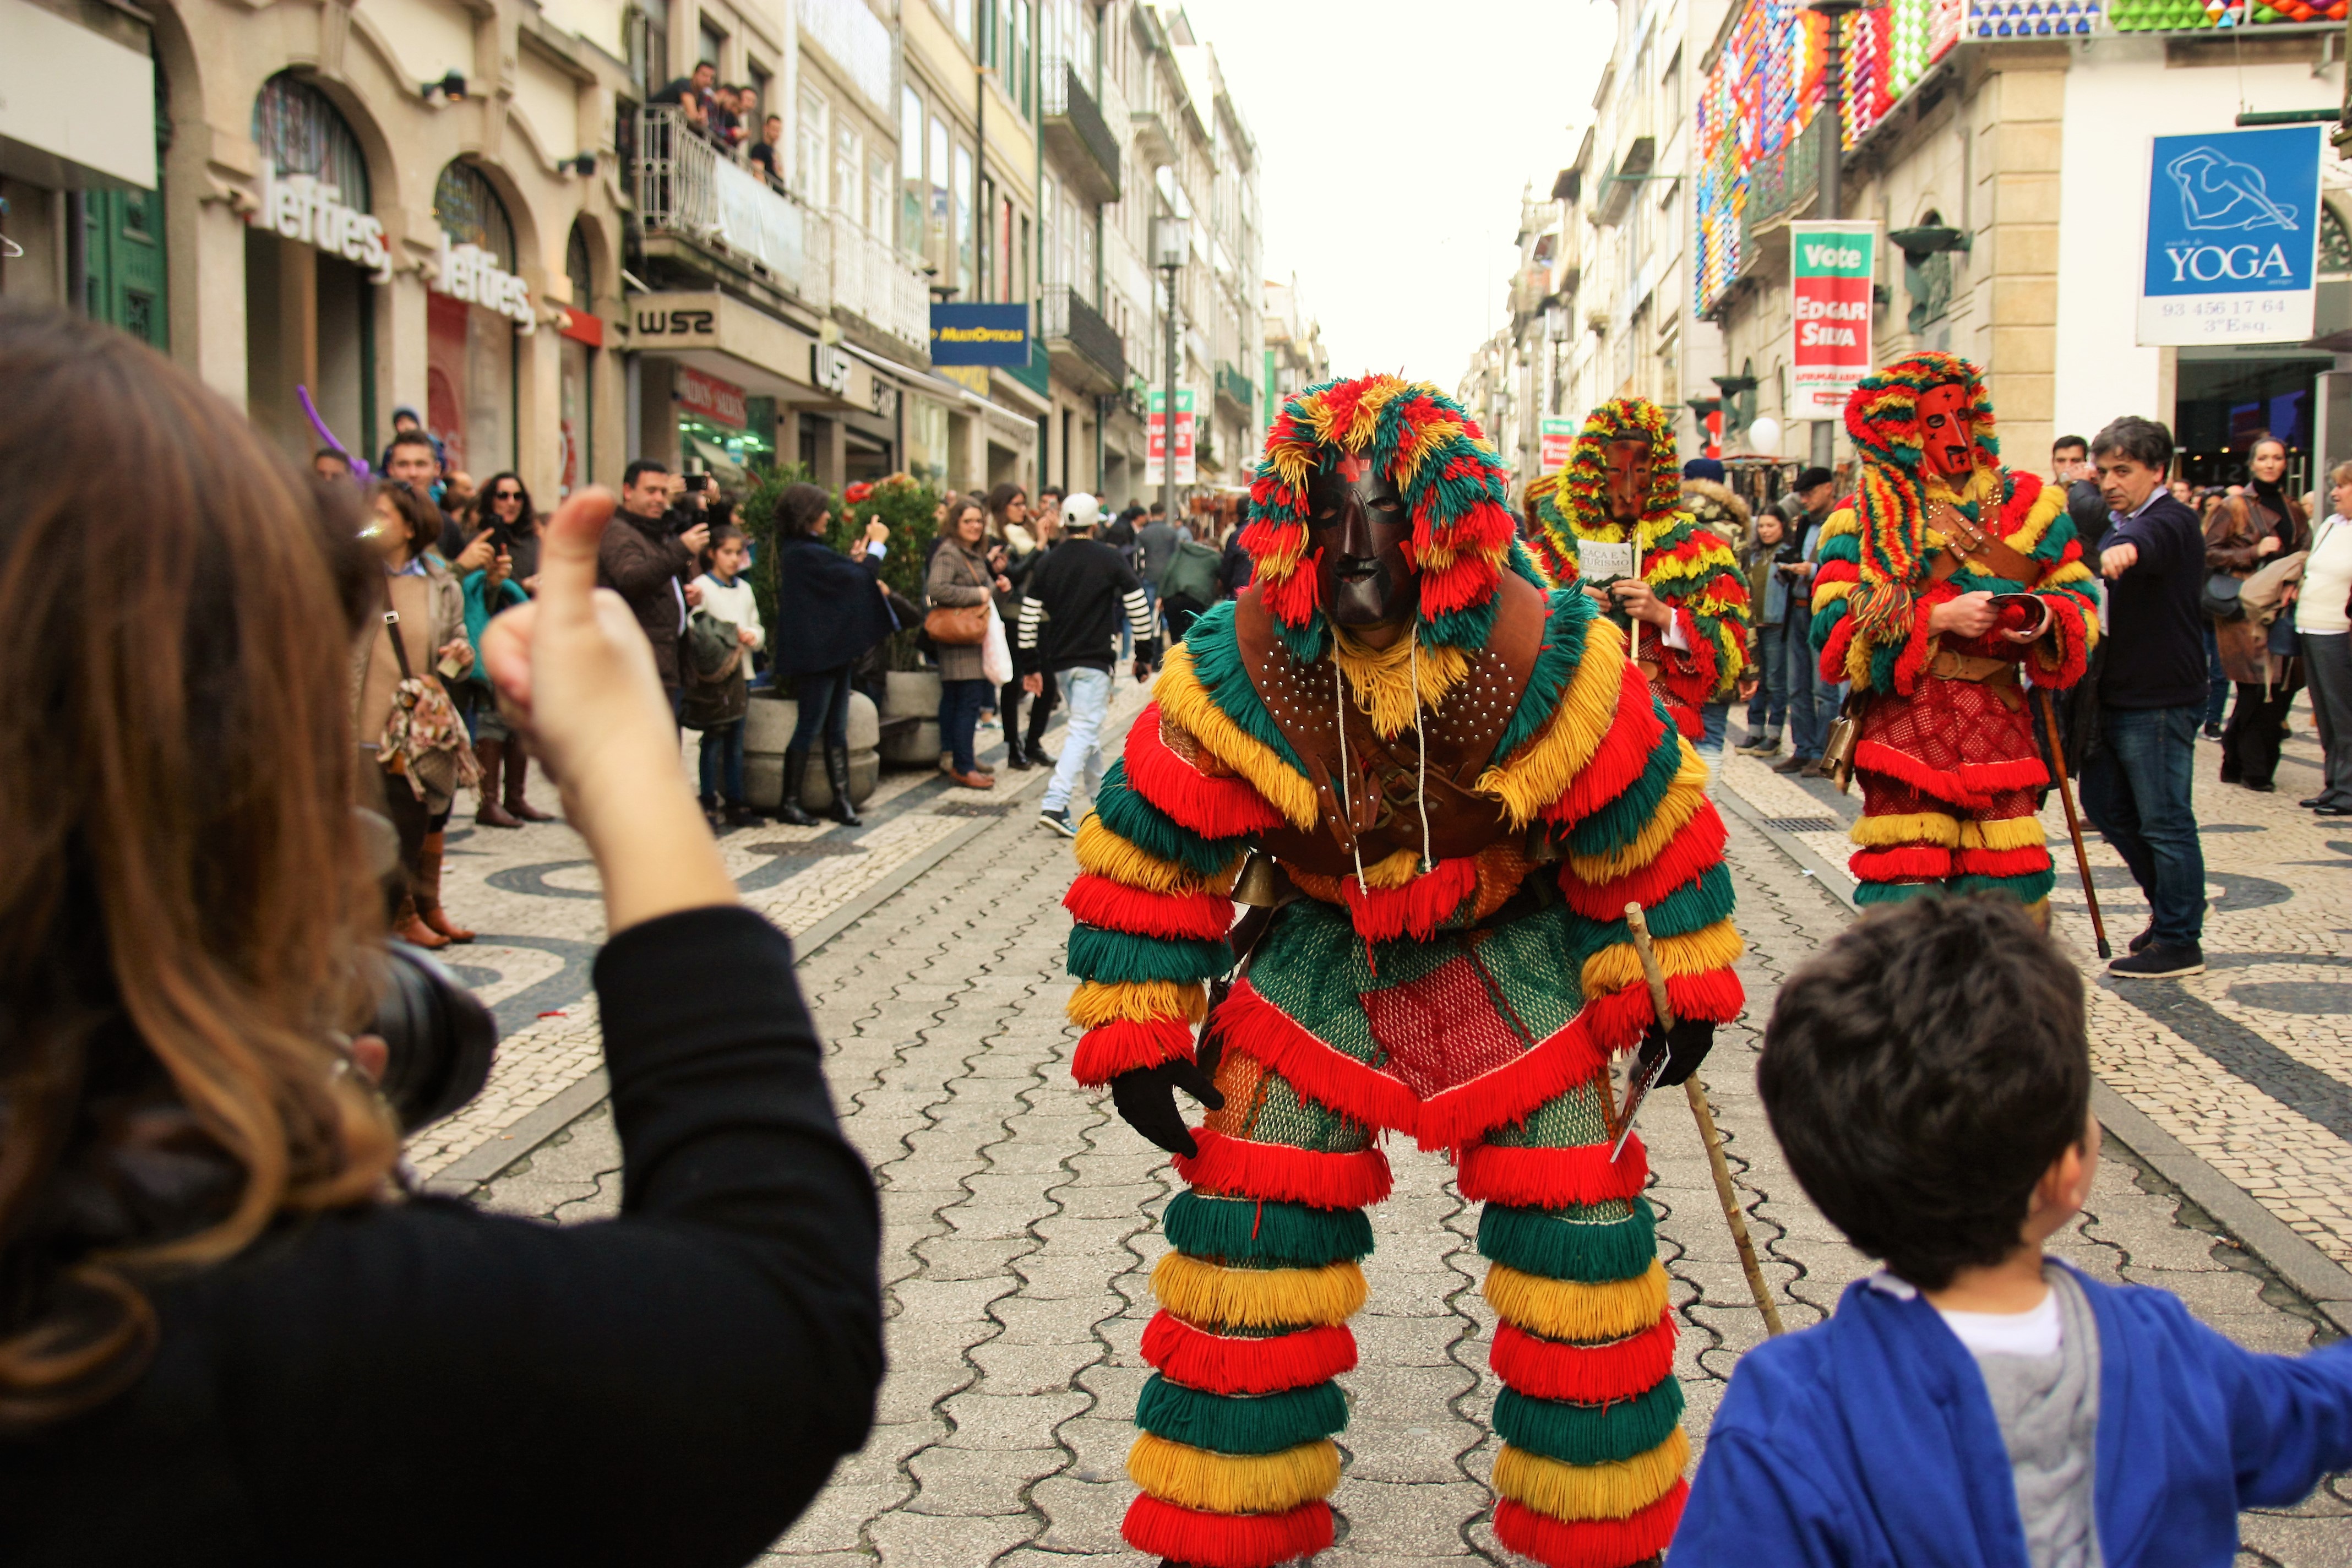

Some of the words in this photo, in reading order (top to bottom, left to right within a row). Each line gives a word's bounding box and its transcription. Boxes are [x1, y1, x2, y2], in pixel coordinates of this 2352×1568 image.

[1804, 244, 1862, 269] Vote
[2165, 243, 2294, 281] YOGA
[1796, 296, 1867, 320] EDGAR
[2162, 303, 2185, 317] 93
[2233, 301, 2255, 314] 17
[2262, 299, 2285, 313] 64
[1800, 321, 1857, 347] SILVA
[1582, 556, 1629, 567] TURISMO
